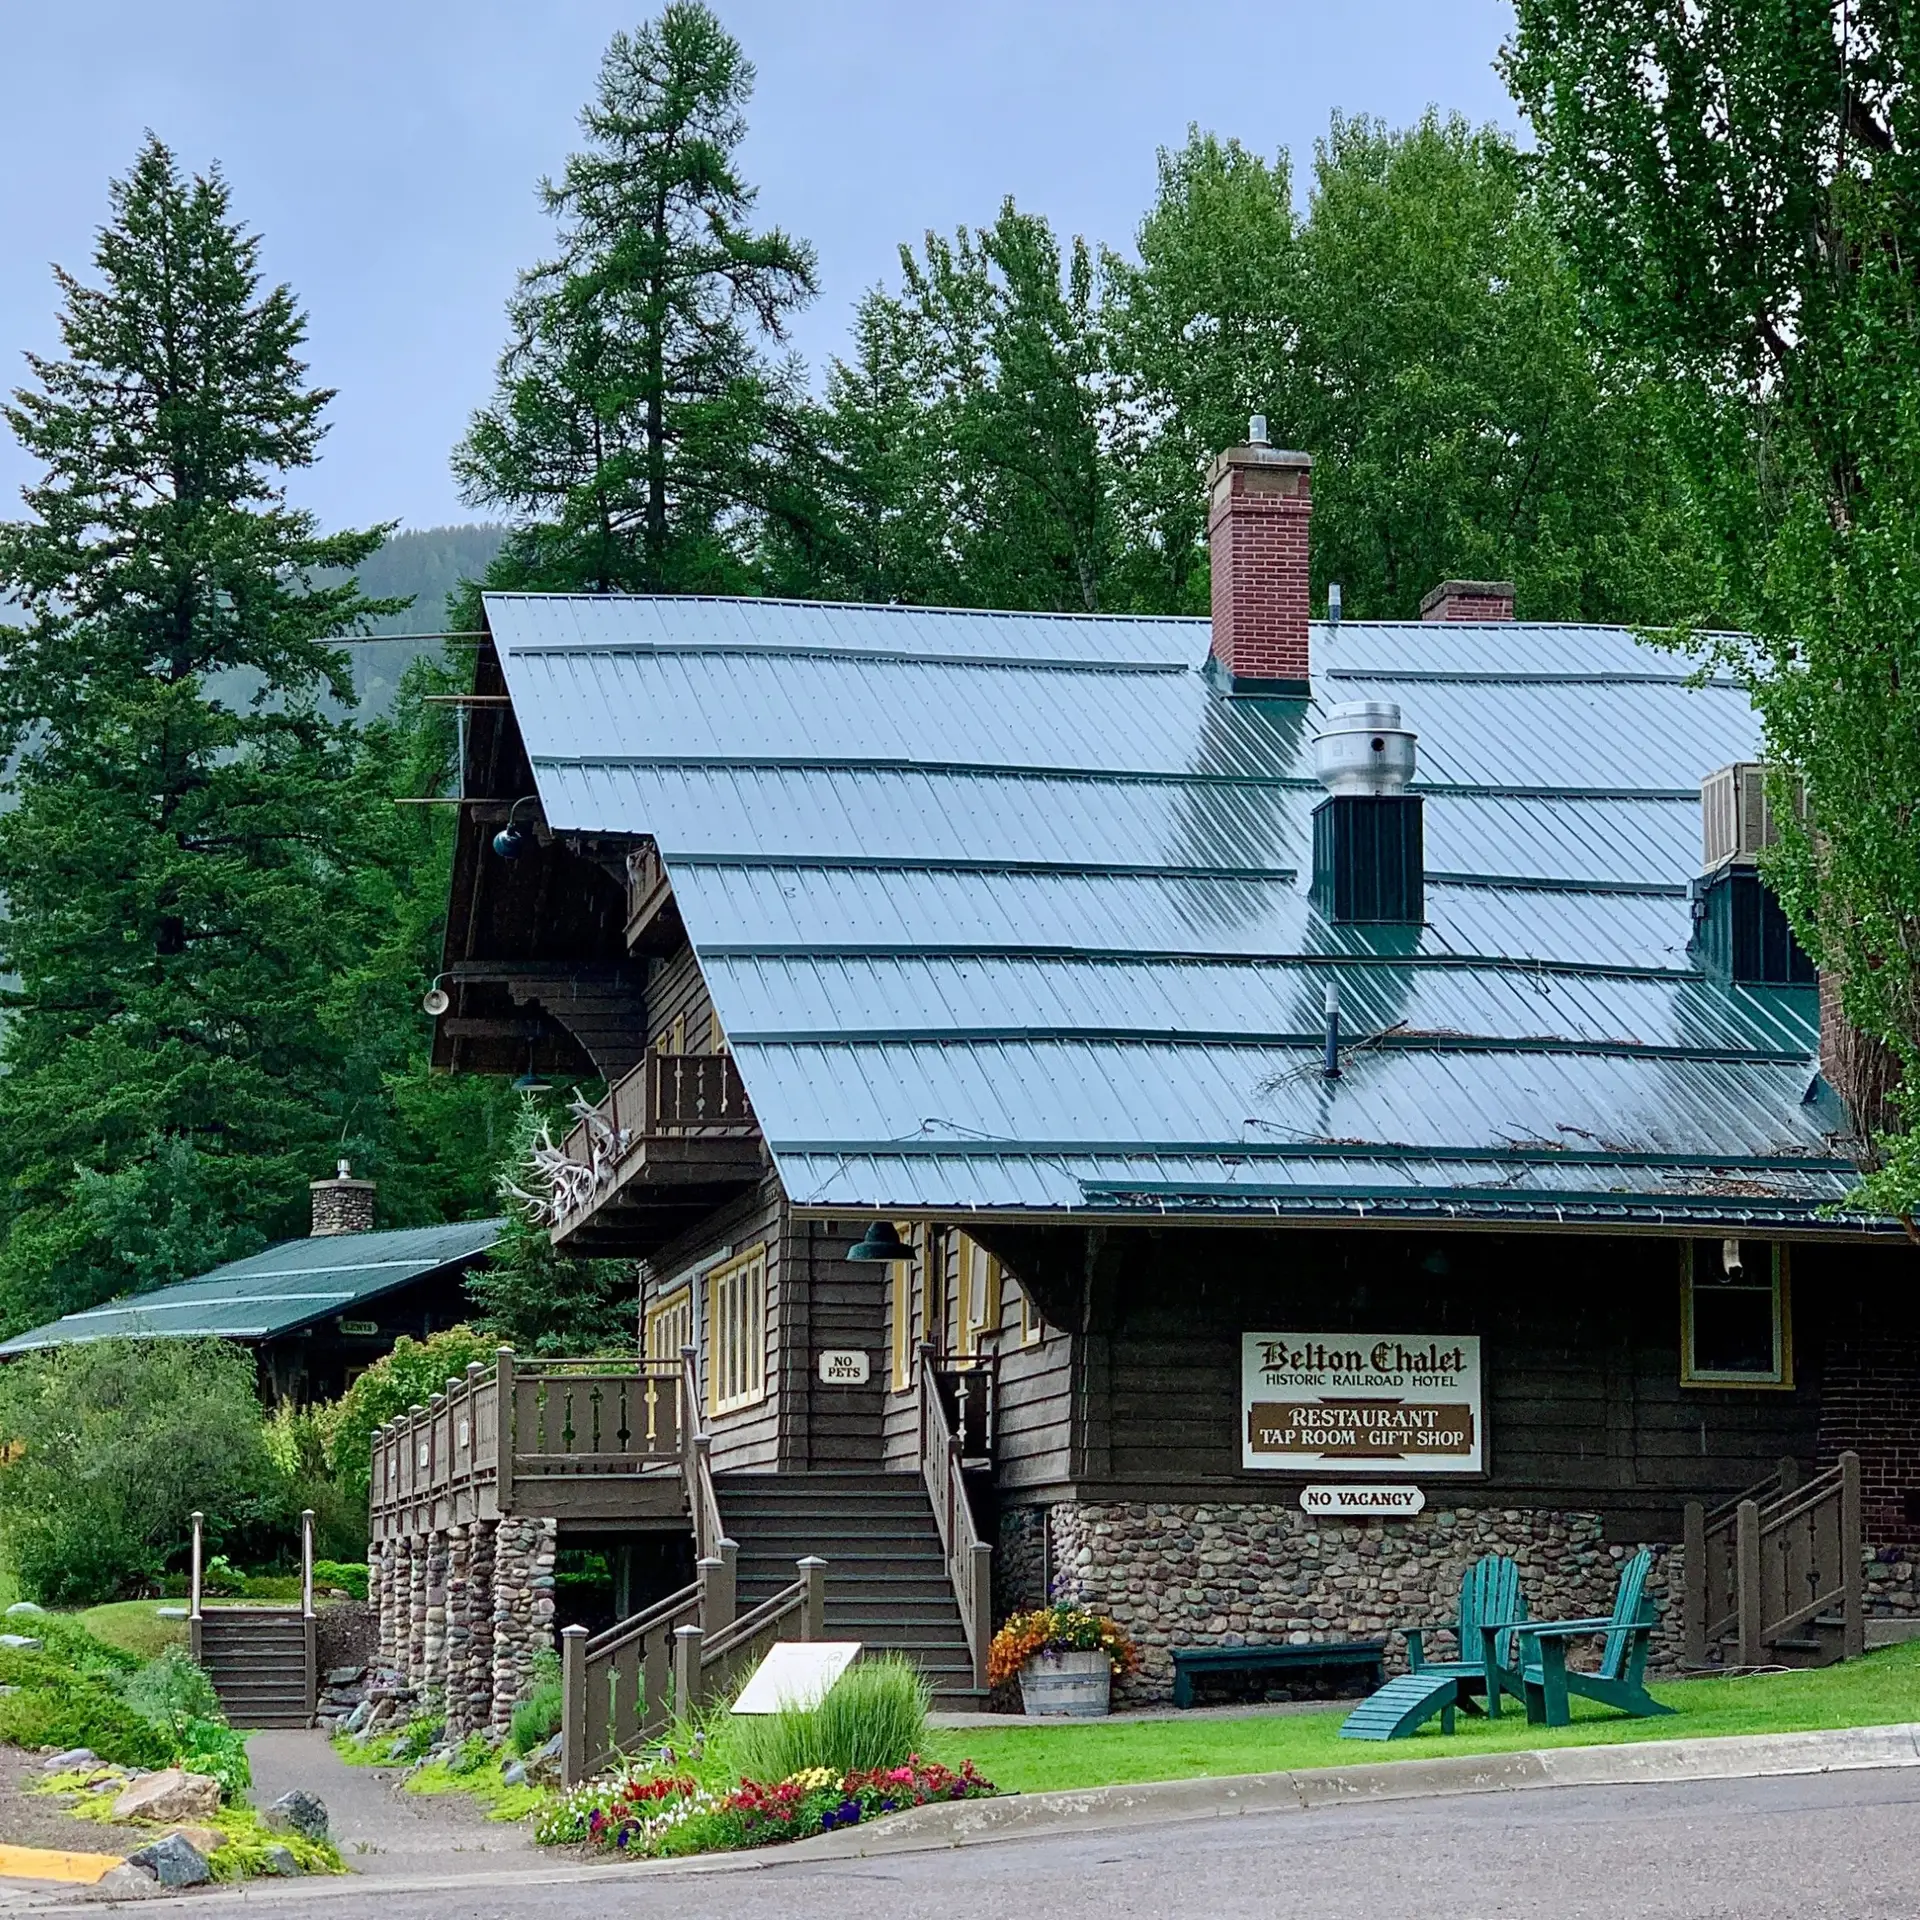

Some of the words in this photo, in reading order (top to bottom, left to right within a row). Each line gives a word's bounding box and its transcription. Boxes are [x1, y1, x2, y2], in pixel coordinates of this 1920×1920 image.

[834, 1356, 852, 1367] NO
[1255, 1341, 1368, 1373] Belton
[1371, 1341, 1468, 1374] Chalet
[828, 1367, 860, 1378] PETS
[1266, 1373, 1327, 1386] HISTORIC
[1332, 1375, 1404, 1387] RAILROAD
[1412, 1375, 1458, 1387] HOTEL
[1289, 1408, 1438, 1428] RESTAURANT
[1260, 1429, 1296, 1445] TAP
[1301, 1429, 1356, 1445] ROOM
[1368, 1430, 1413, 1446] GIFT
[1417, 1431, 1464, 1446] SHOP
[1308, 1493, 1331, 1506] NO
[1337, 1492, 1415, 1506] VACANCY
